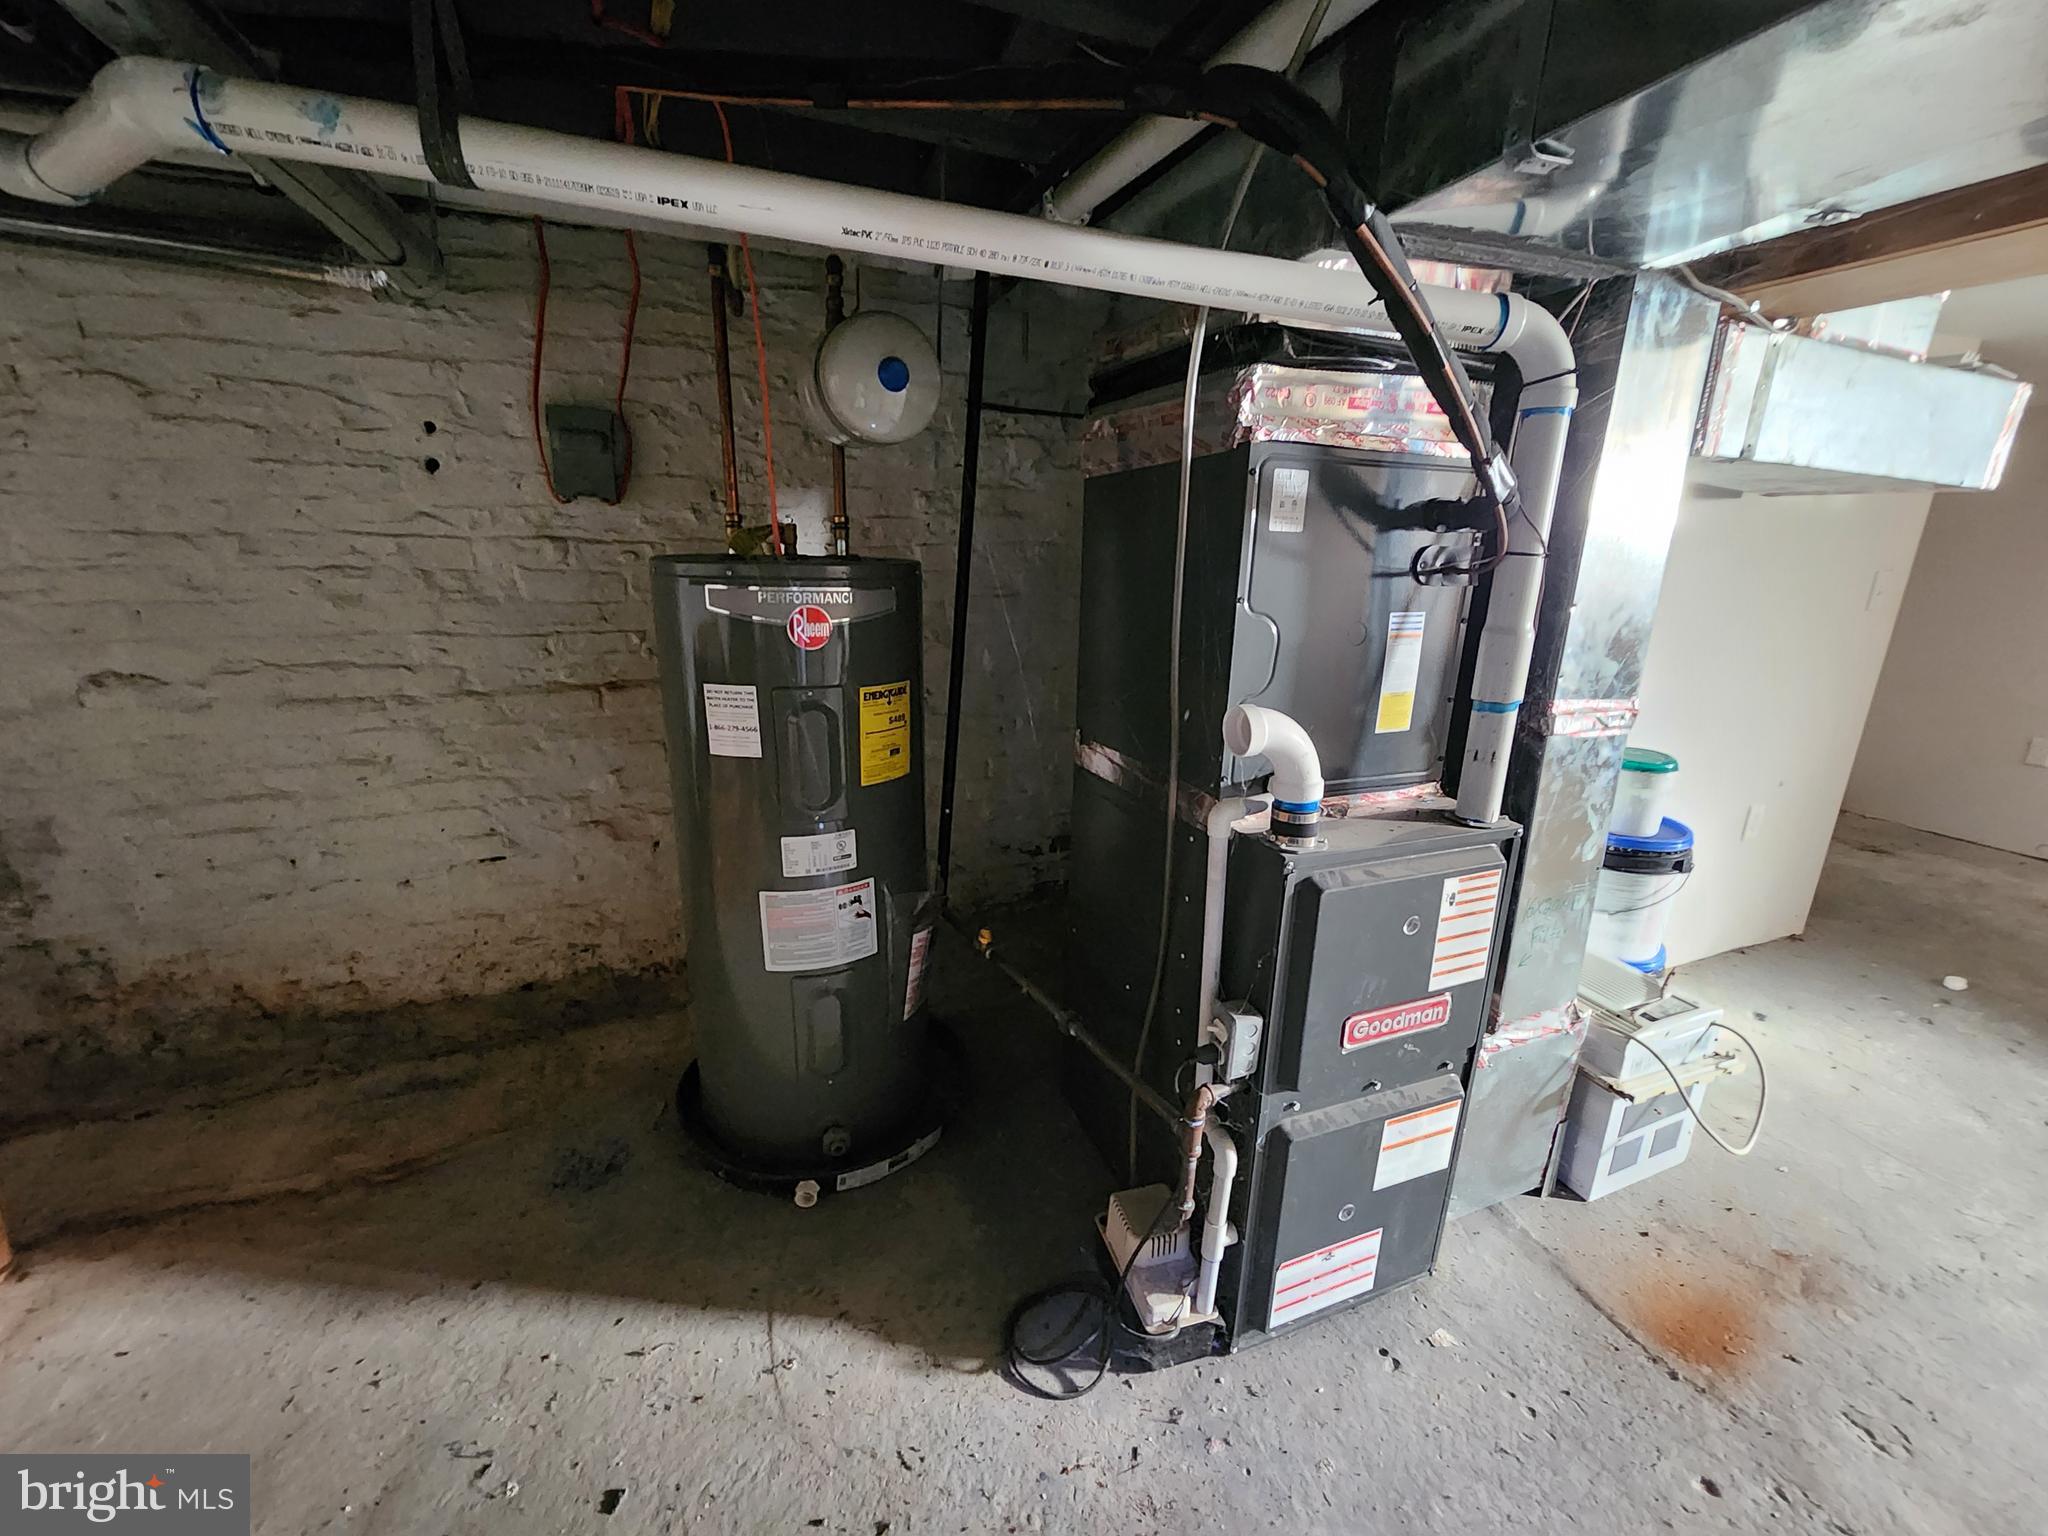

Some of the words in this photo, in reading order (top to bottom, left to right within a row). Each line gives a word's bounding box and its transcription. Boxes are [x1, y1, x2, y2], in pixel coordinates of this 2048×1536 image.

[656, 196, 688, 209] IPEX
[1461, 325, 1484, 336] IPEX
[793, 608, 830, 644] Rheem
[1353, 1006, 1444, 1039] Goodman
